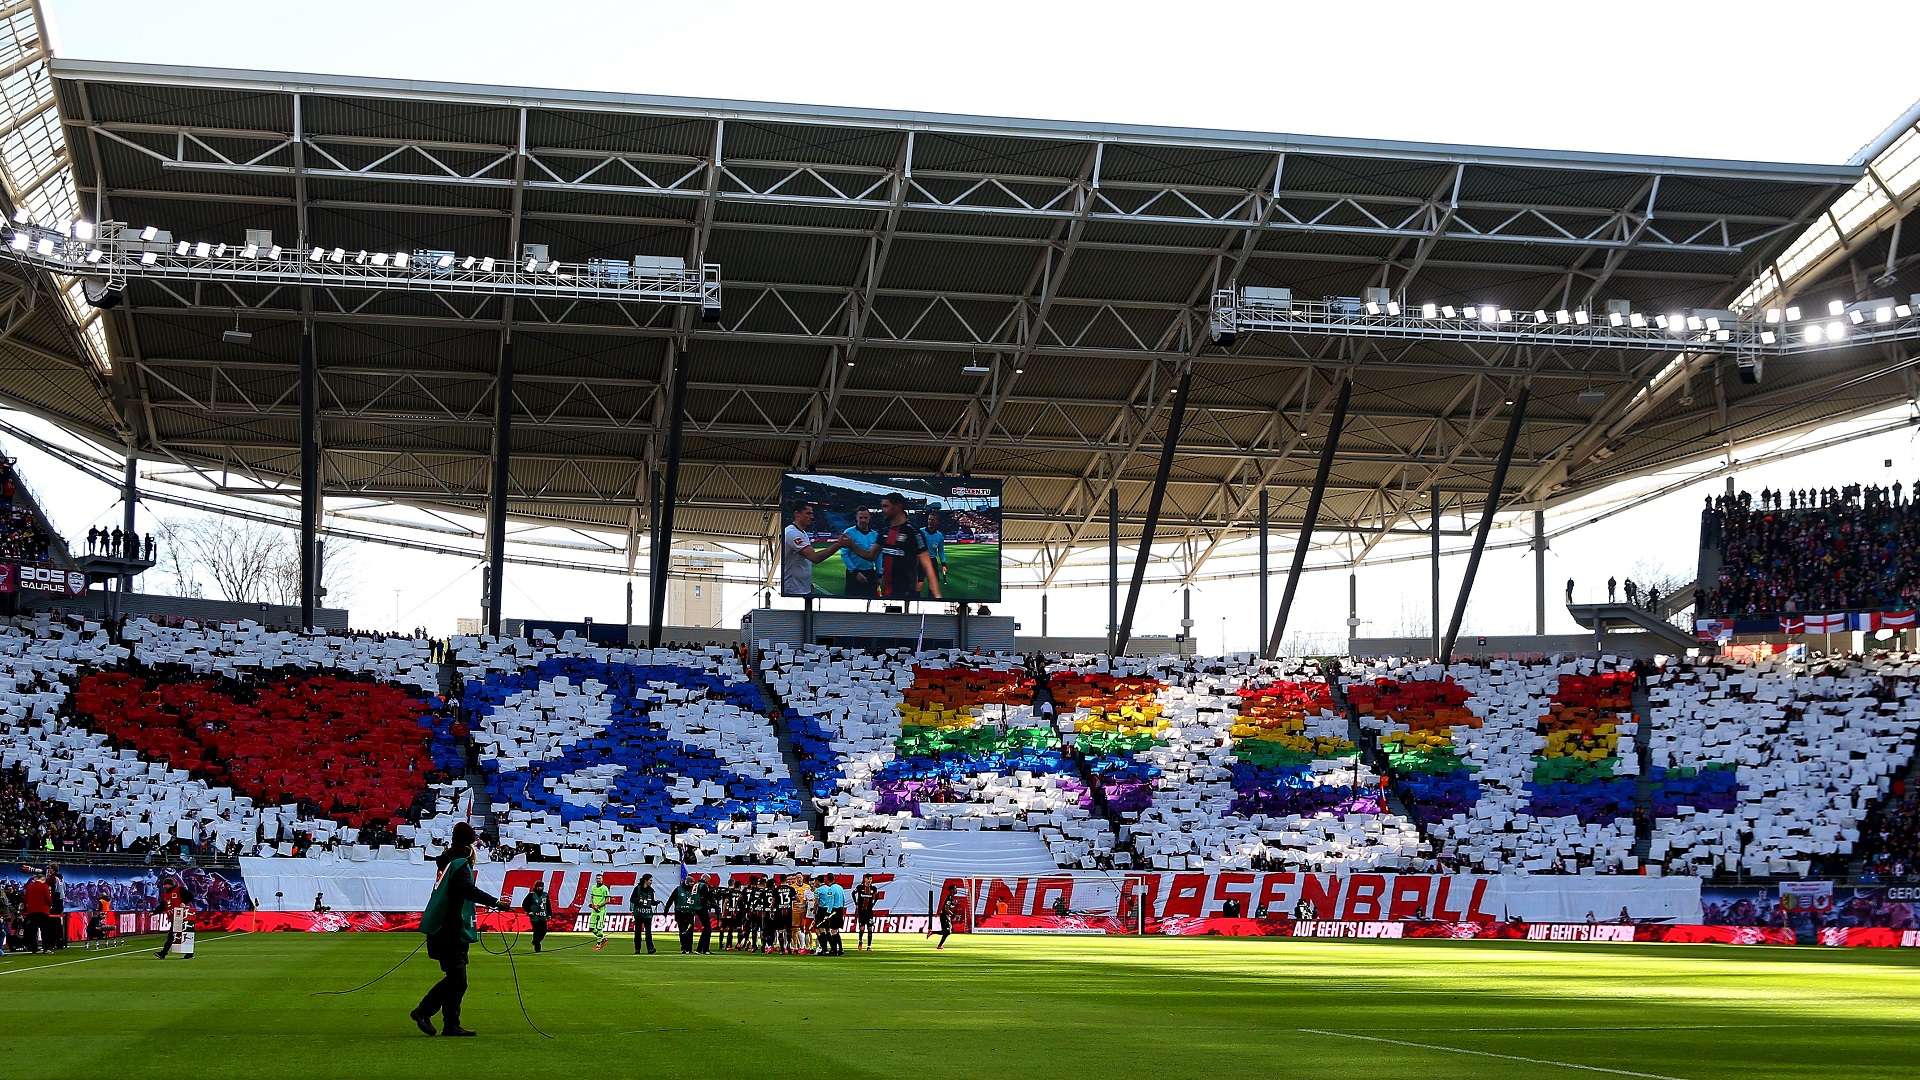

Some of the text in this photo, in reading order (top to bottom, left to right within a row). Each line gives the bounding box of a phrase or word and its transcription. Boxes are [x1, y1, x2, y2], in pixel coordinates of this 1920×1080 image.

[20, 566, 65, 583] BOS
[21, 581, 65, 592] GAURUS
[473, 869, 637, 913] OVE
[1116, 872, 1497, 922] RASENBALL
[779, 892, 791, 904] 13
[573, 914, 592, 932] AU
[840, 916, 856, 932] UF
[1293, 921, 1317, 937] AUF
[1316, 921, 1357, 938] GEHT'S
[1527, 924, 1551, 940] AUF
[1550, 924, 1591, 941] GEHT'S
